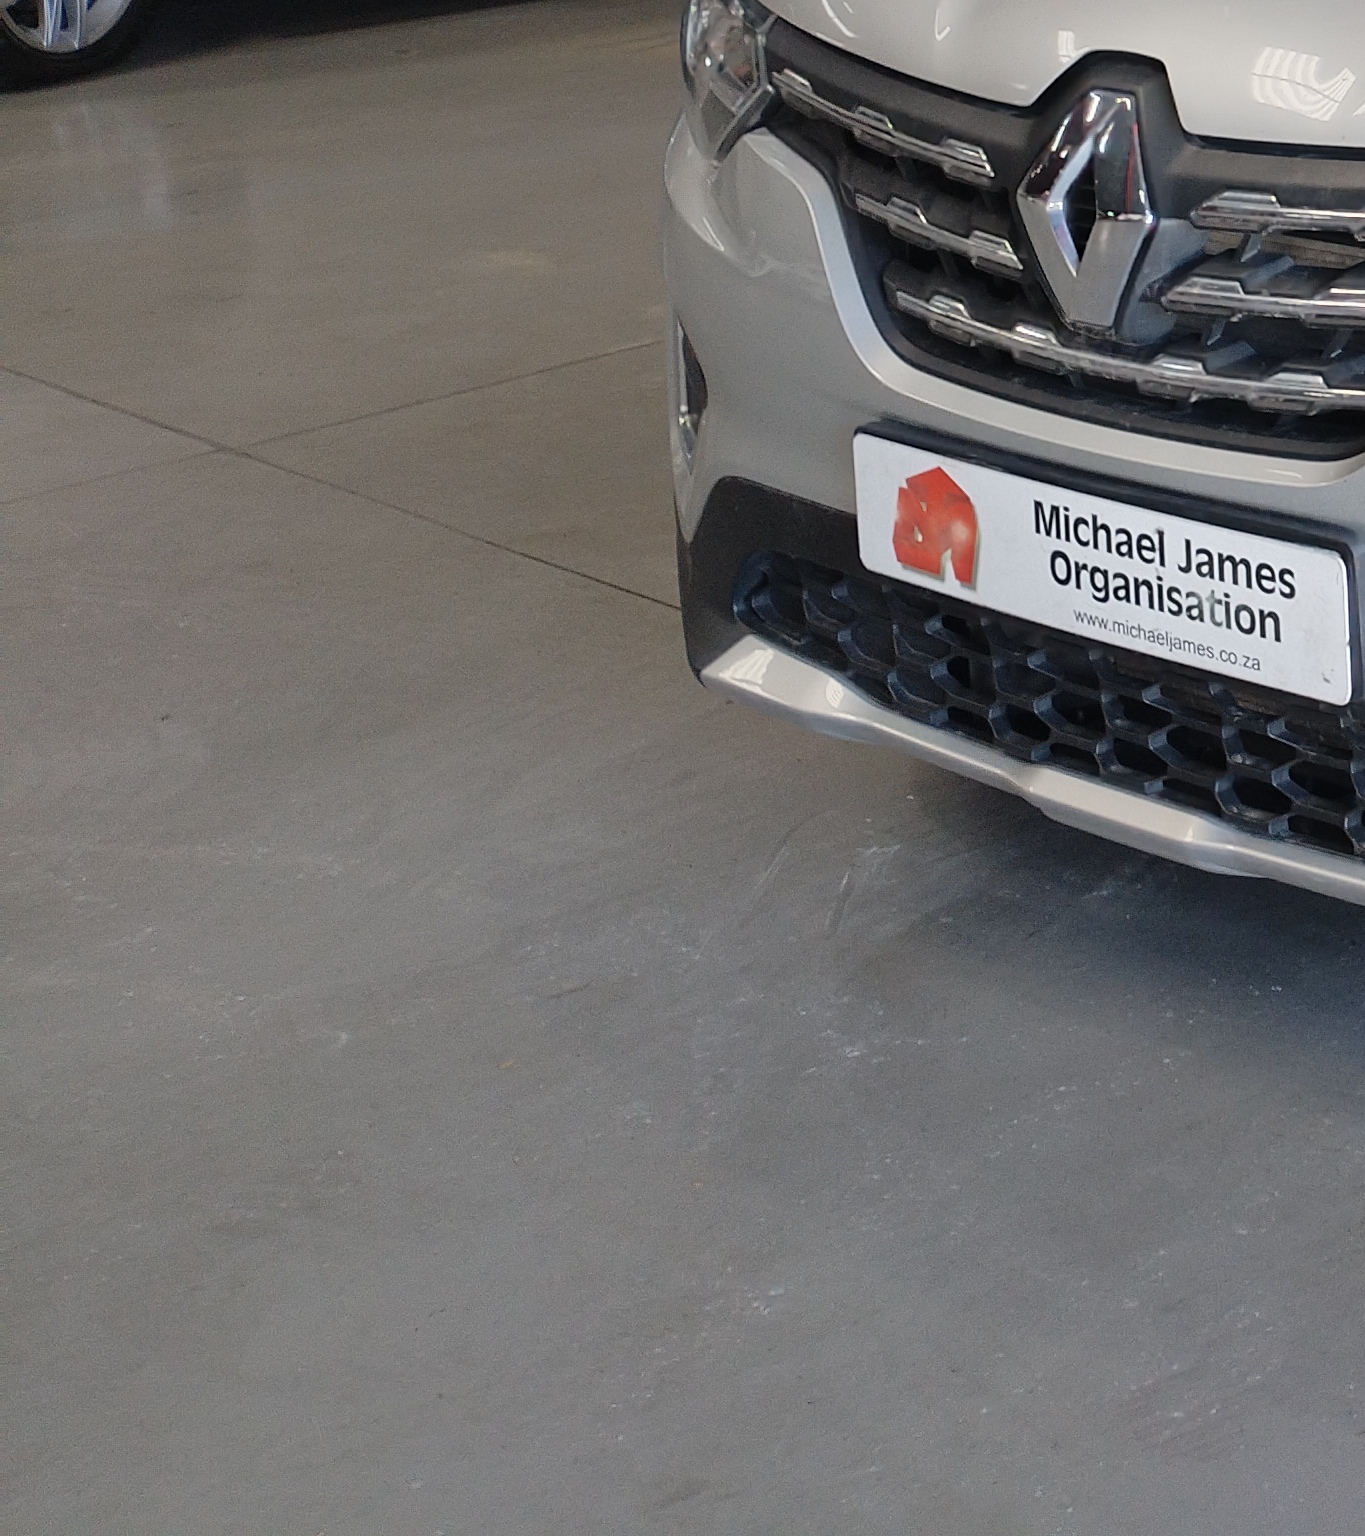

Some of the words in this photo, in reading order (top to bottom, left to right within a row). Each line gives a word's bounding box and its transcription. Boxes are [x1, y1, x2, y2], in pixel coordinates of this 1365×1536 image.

[1032, 499, 1167, 568] Michael
[1175, 538, 1297, 601] James
[1049, 549, 1283, 643] Organisation
[1073, 608, 1262, 672] www.michaeljames.co.za
